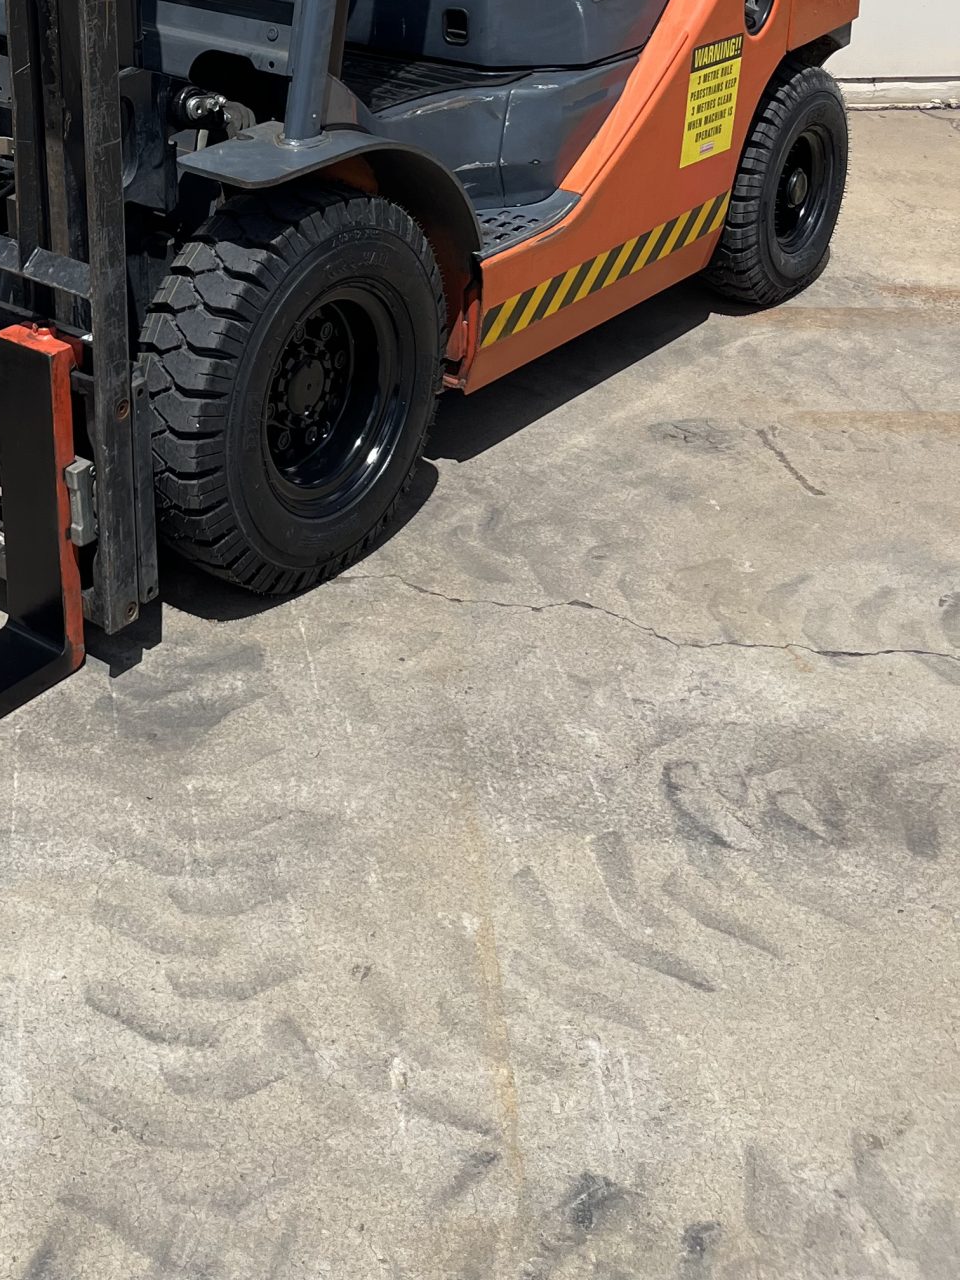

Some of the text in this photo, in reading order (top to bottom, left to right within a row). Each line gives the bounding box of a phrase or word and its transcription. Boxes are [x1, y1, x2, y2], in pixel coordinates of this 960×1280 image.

[694, 36, 742, 68] WARNING!!
[697, 64, 733, 85] 3 METRE RULE
[690, 77, 737, 102] PEDESTRIANS KEEP
[691, 93, 732, 116] 3 METRES CLEAR
[687, 106, 734, 132] WHEN MACHINE IS
[695, 124, 722, 143] OPERATING
